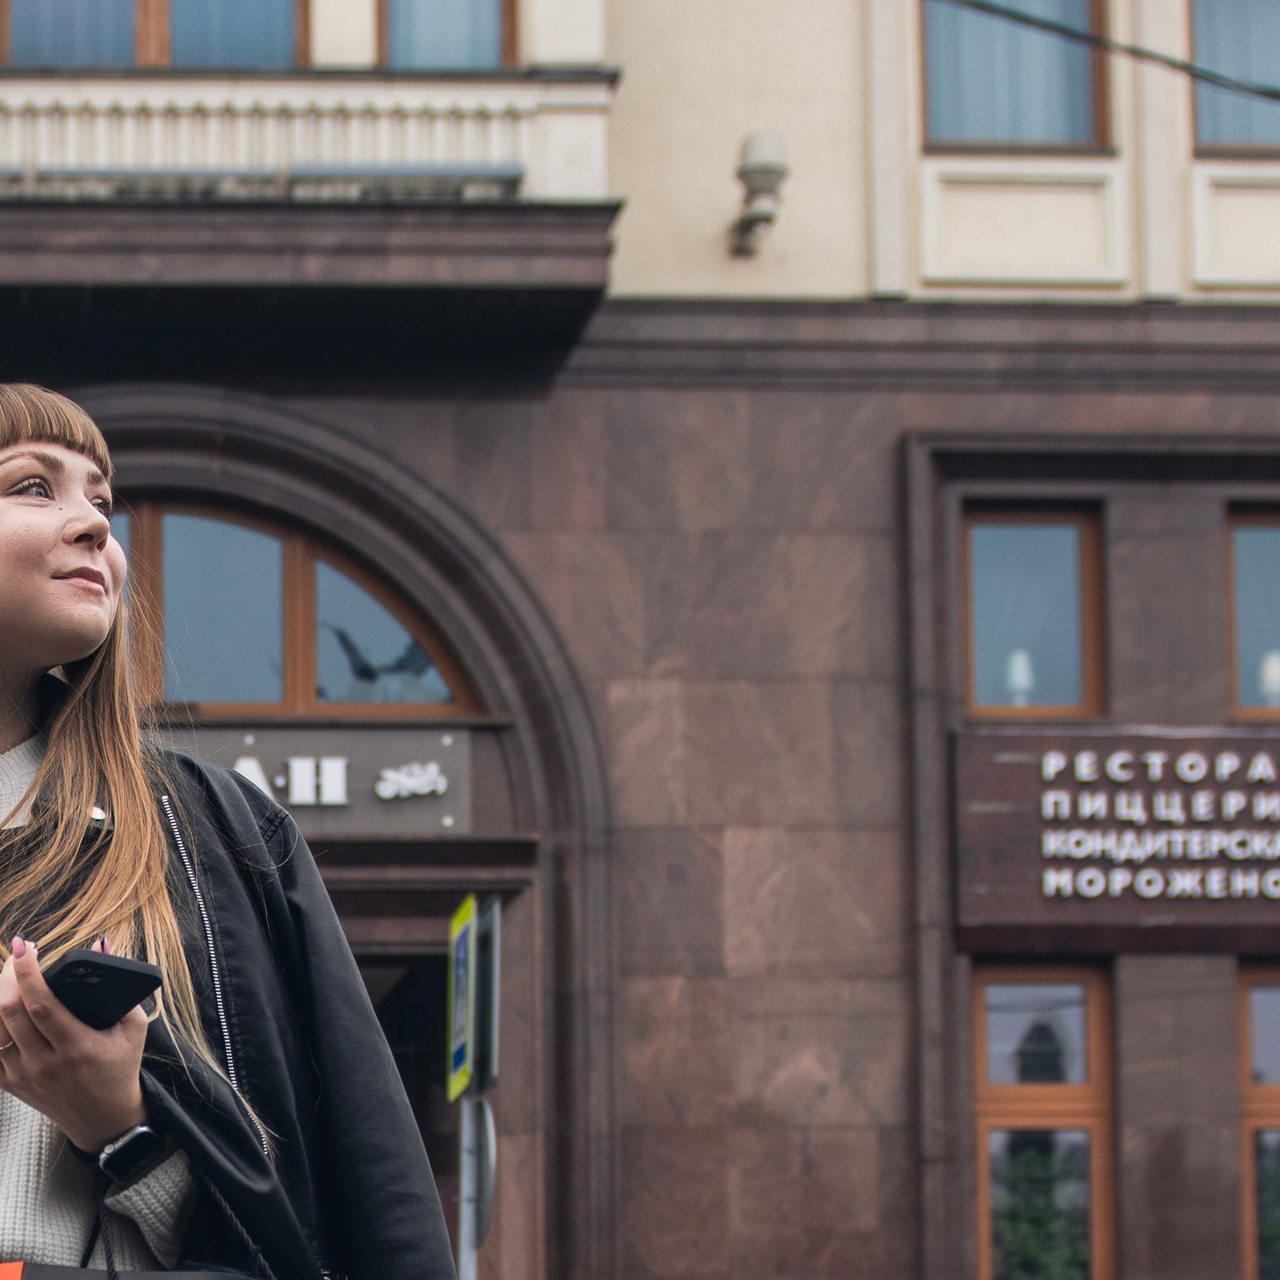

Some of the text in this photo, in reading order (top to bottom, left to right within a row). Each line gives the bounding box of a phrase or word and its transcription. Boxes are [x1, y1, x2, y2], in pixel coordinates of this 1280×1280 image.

[1042, 751, 1276, 783] РЕСТОРА
[1042, 791, 1280, 825] ПИЦЦЕРИ
[1042, 868, 1280, 898] МОРОЖЕНО
